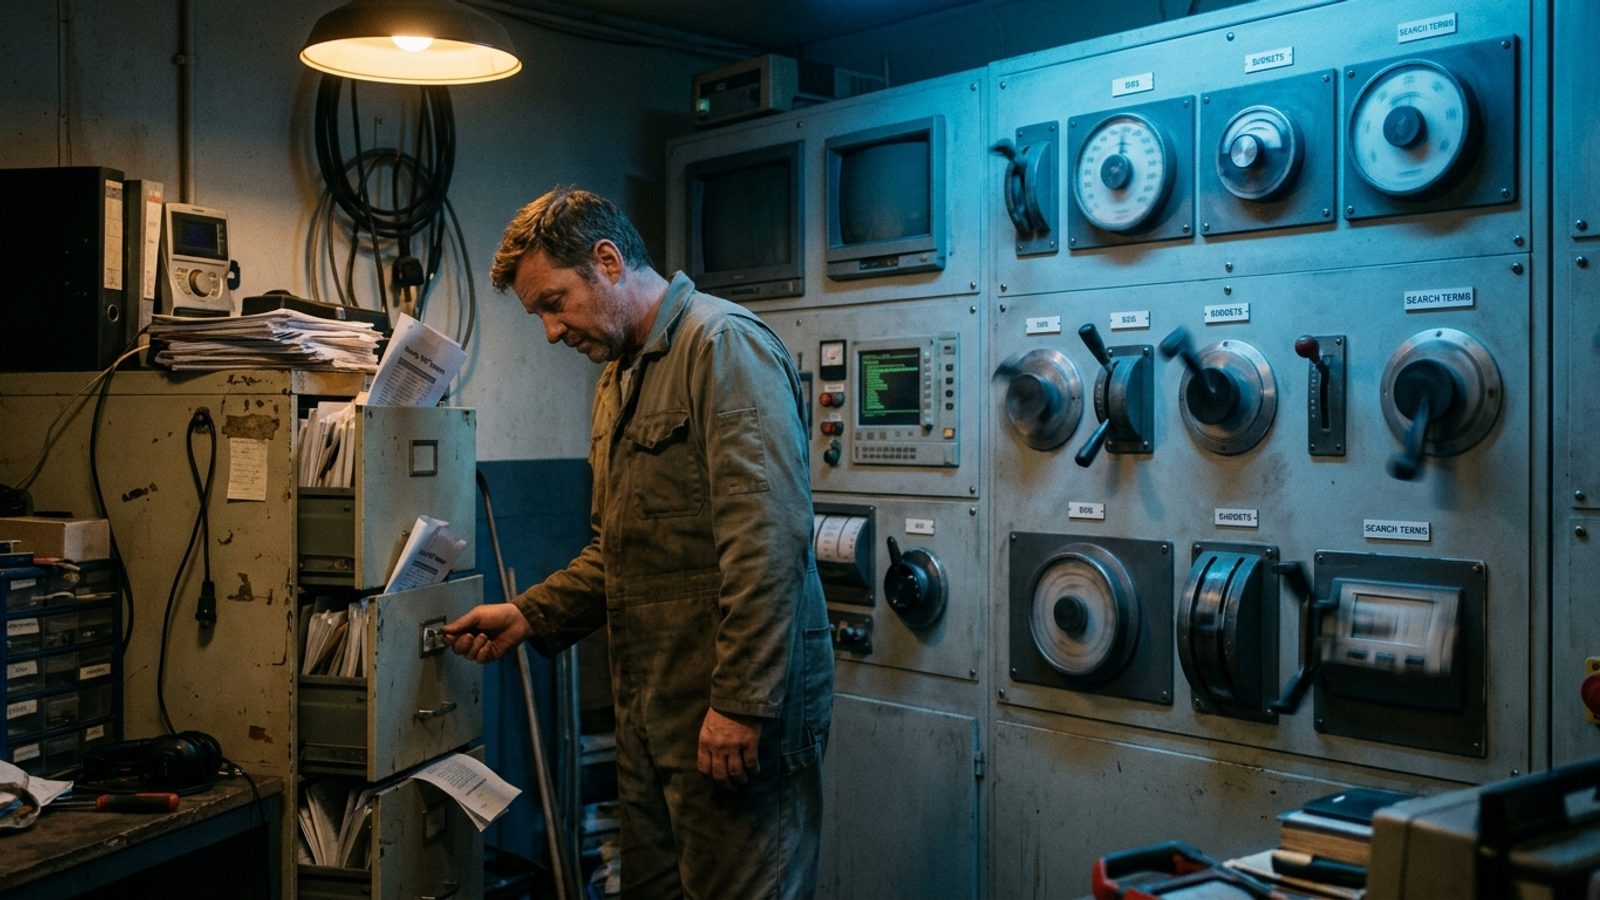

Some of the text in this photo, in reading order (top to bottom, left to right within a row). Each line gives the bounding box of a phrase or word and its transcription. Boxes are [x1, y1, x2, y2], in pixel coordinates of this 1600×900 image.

[1406, 292, 1471, 305] SEARCH TERMS
[1365, 524, 1428, 535] SEARCH TERMS
